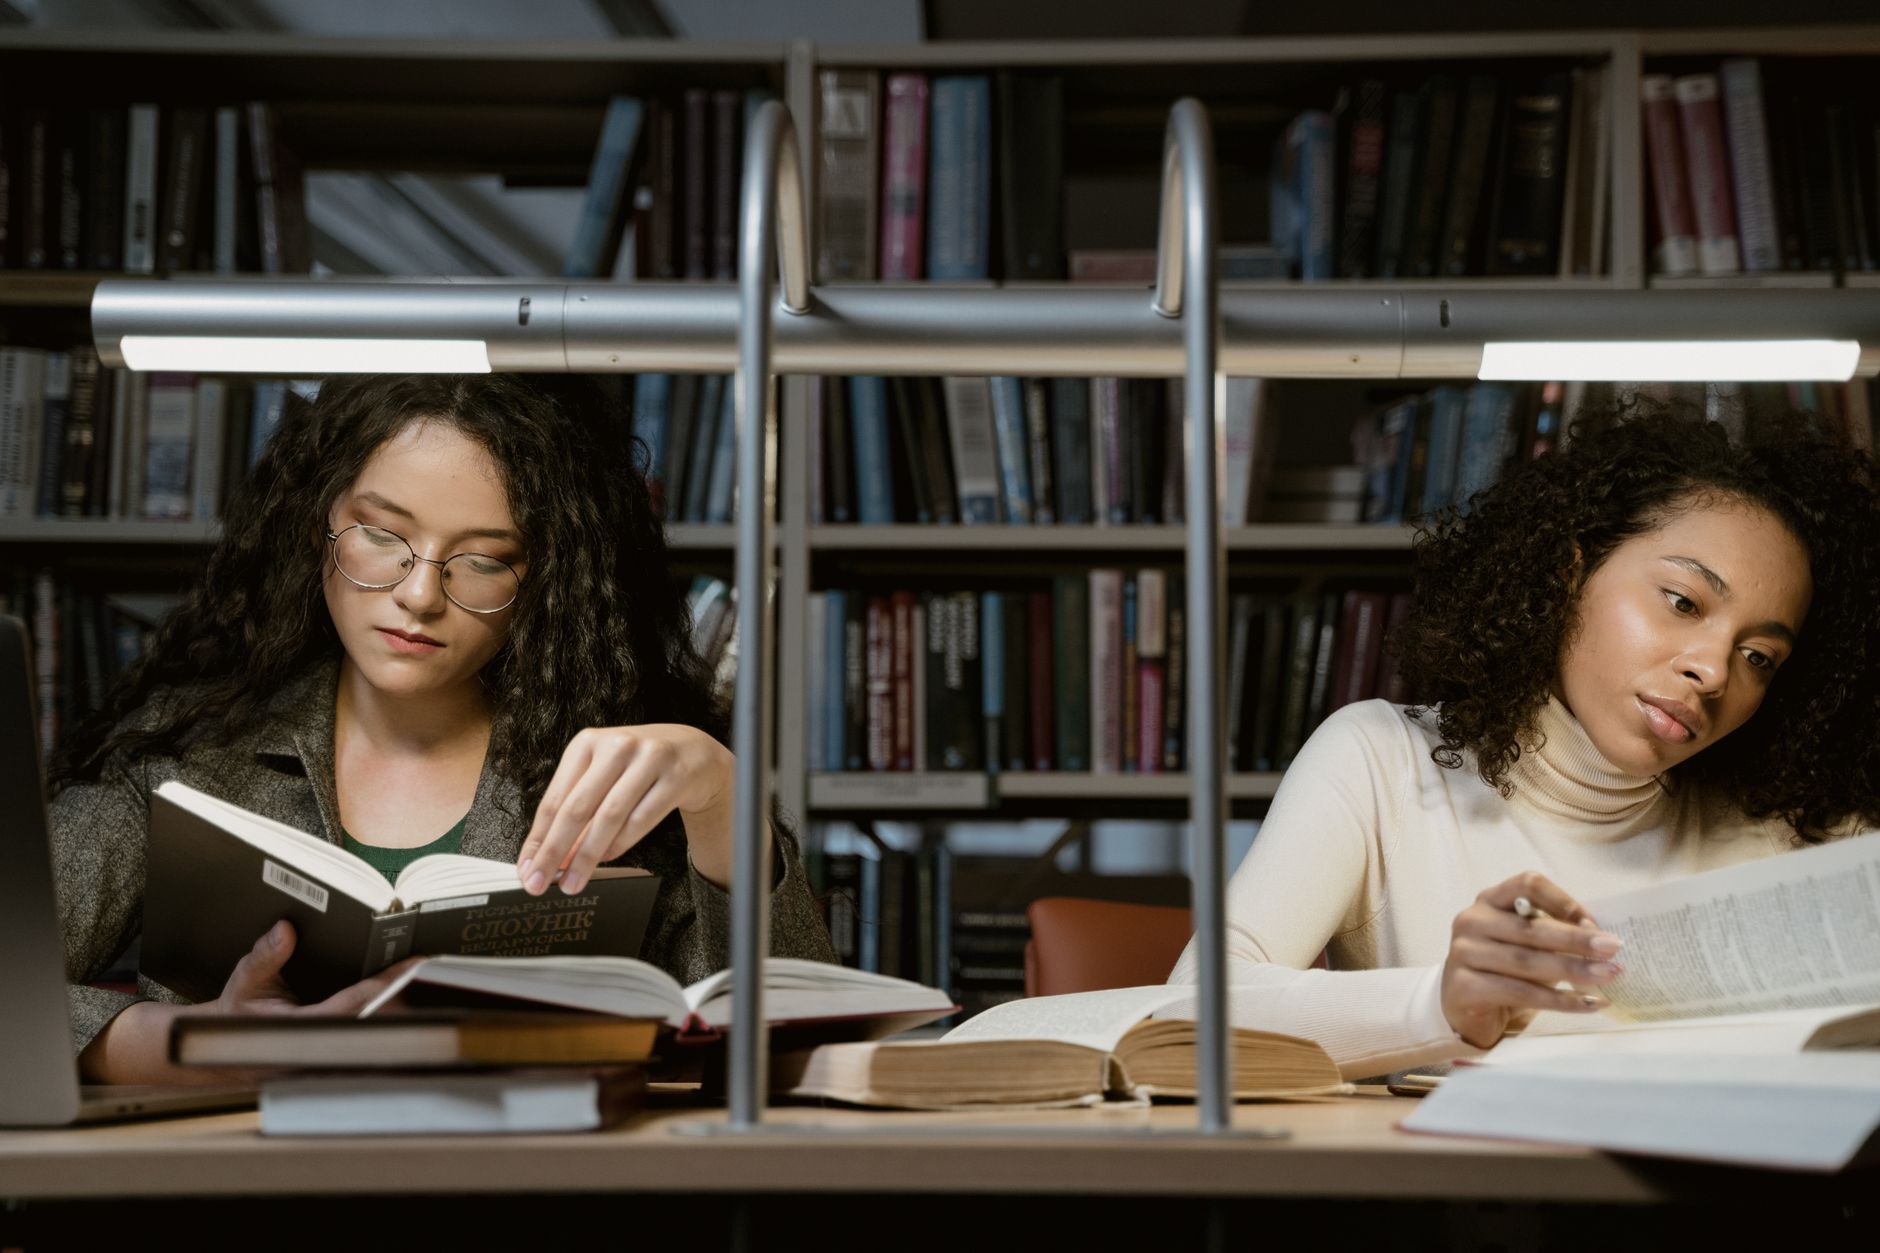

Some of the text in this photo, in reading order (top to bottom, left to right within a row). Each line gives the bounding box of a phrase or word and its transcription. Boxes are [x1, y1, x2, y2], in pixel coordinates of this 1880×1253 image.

[465, 896, 600, 920] ГІСТАРЫЧНЫ
[461, 910, 595, 941] СЛОЎНІК
[459, 930, 589, 954] БЕЛАРУСКАЙ
